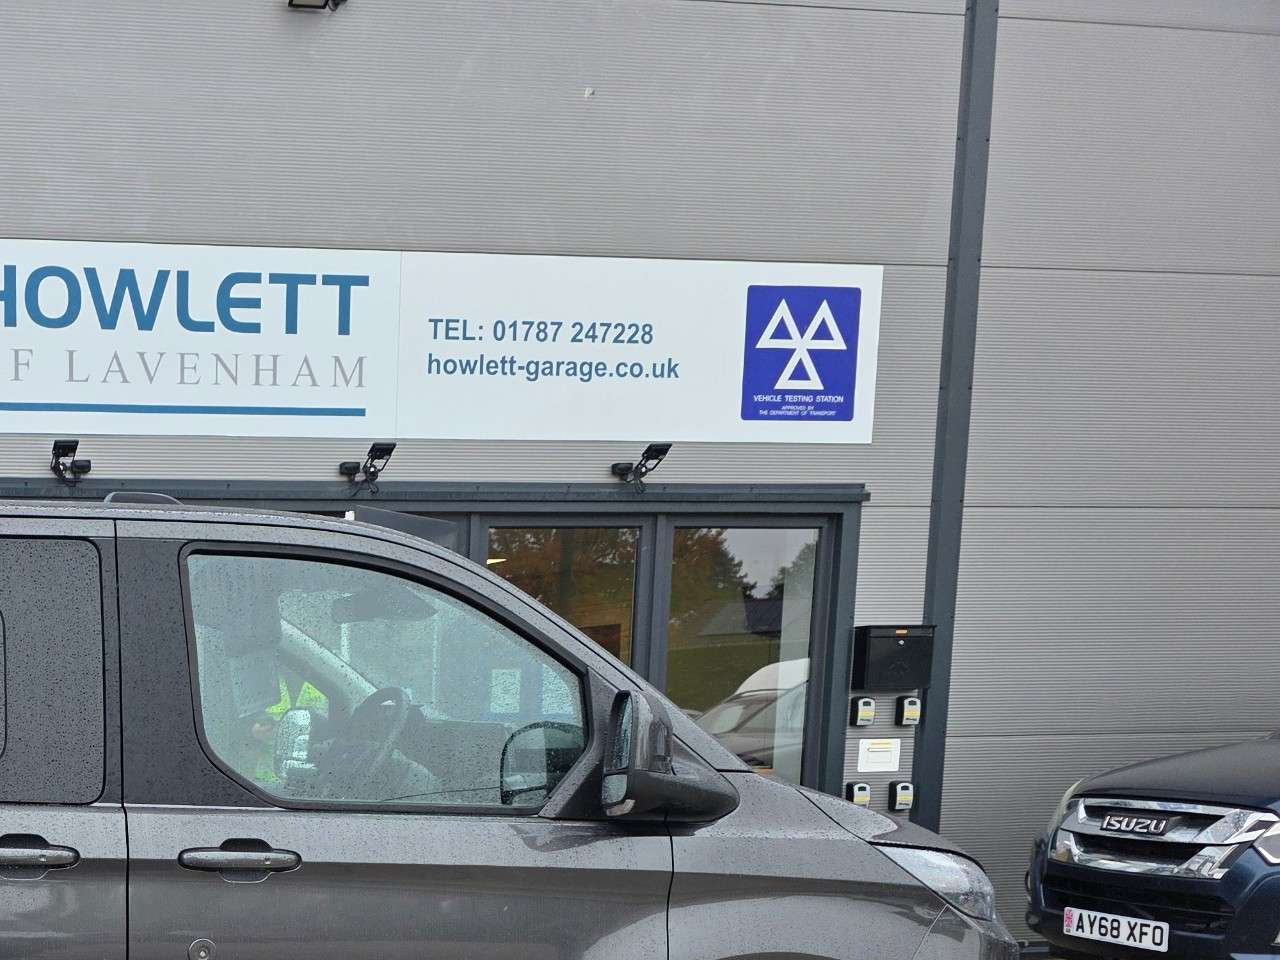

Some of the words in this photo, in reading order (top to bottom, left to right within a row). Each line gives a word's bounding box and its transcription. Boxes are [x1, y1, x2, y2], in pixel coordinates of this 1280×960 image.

[428, 318, 484, 342] TEL:
[492, 320, 563, 344] 01787
[571, 321, 654, 345] 247228
[65, 348, 369, 389] LAVENHAM
[427, 353, 680, 383] howlett-garage.co.uk
[753, 394, 782, 402] VEHICLE
[785, 395, 814, 403] TESTING
[816, 395, 844, 403] STATION
[1102, 815, 1167, 834] ISUZU
[1075, 912, 1121, 939] AY68
[1126, 920, 1164, 947] XFO
